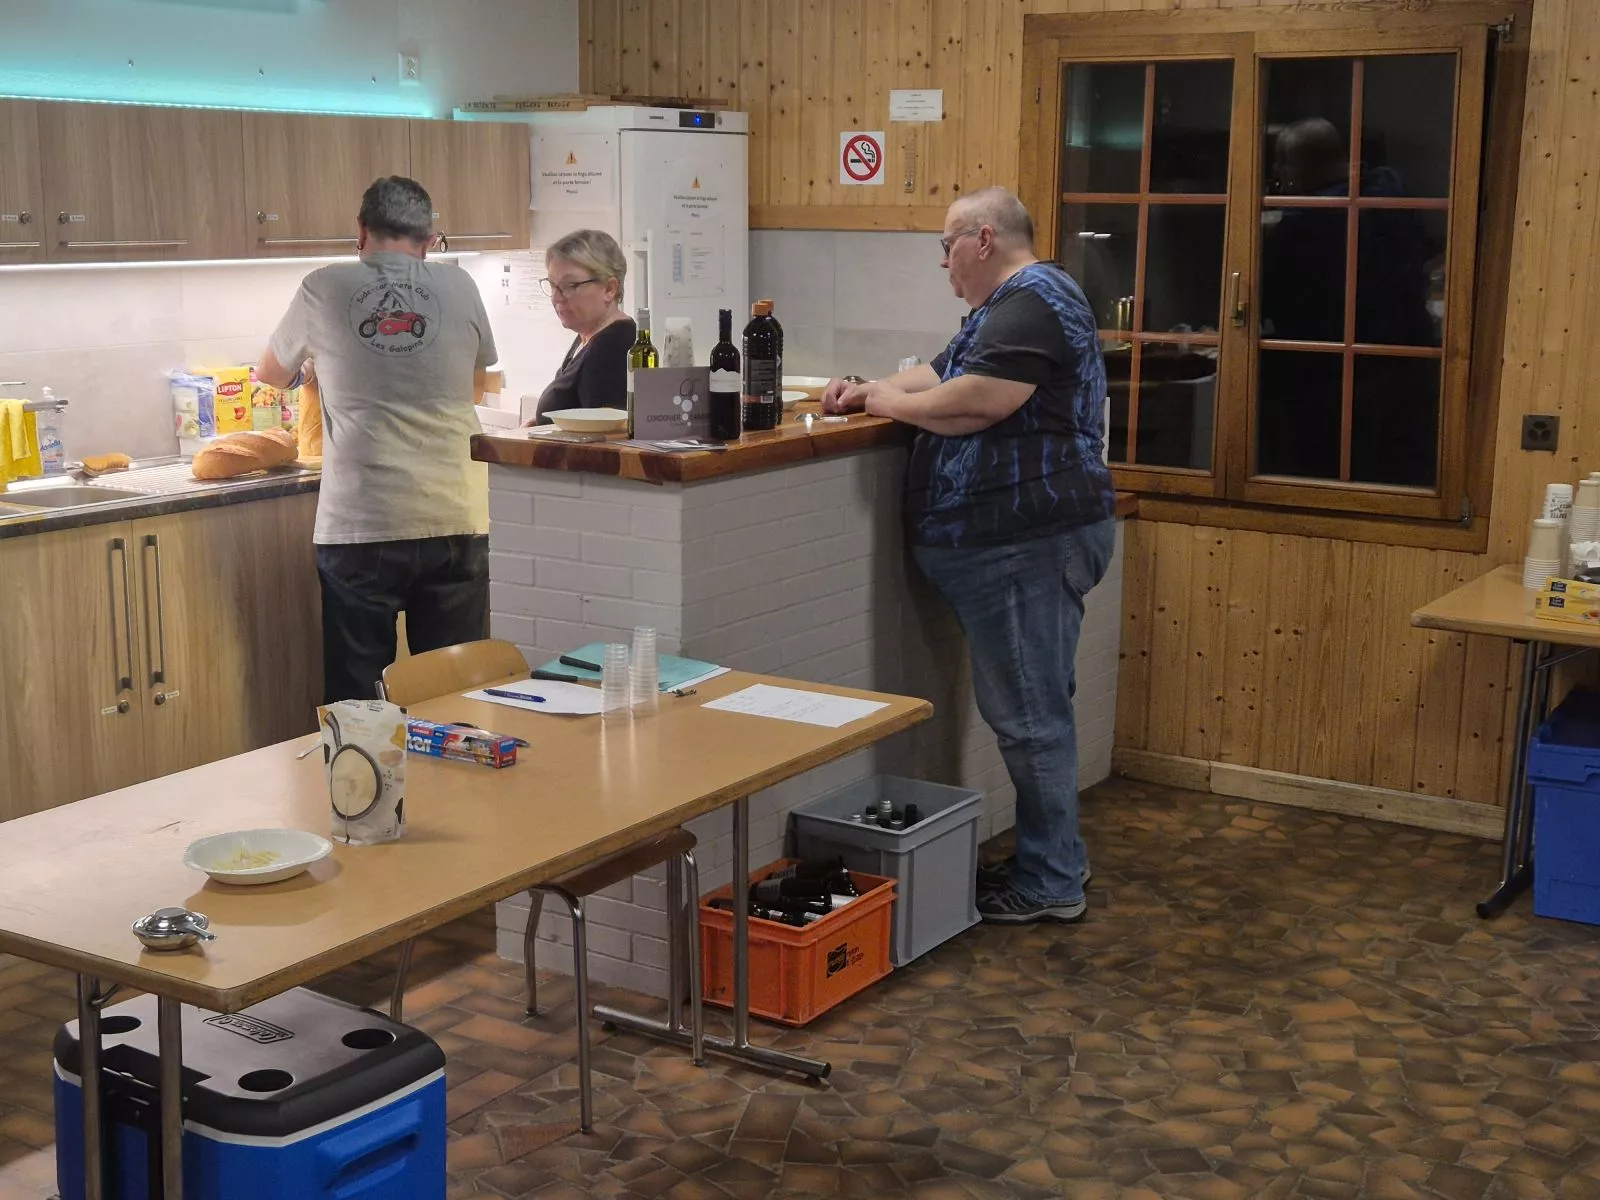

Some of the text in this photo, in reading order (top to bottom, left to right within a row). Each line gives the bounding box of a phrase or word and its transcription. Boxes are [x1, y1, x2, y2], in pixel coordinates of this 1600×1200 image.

[391, 281, 412, 290] Moto
[414, 287, 430, 301] Club
[371, 339, 424, 353] Les Galopins
[217, 383, 242, 394] LIPTON
